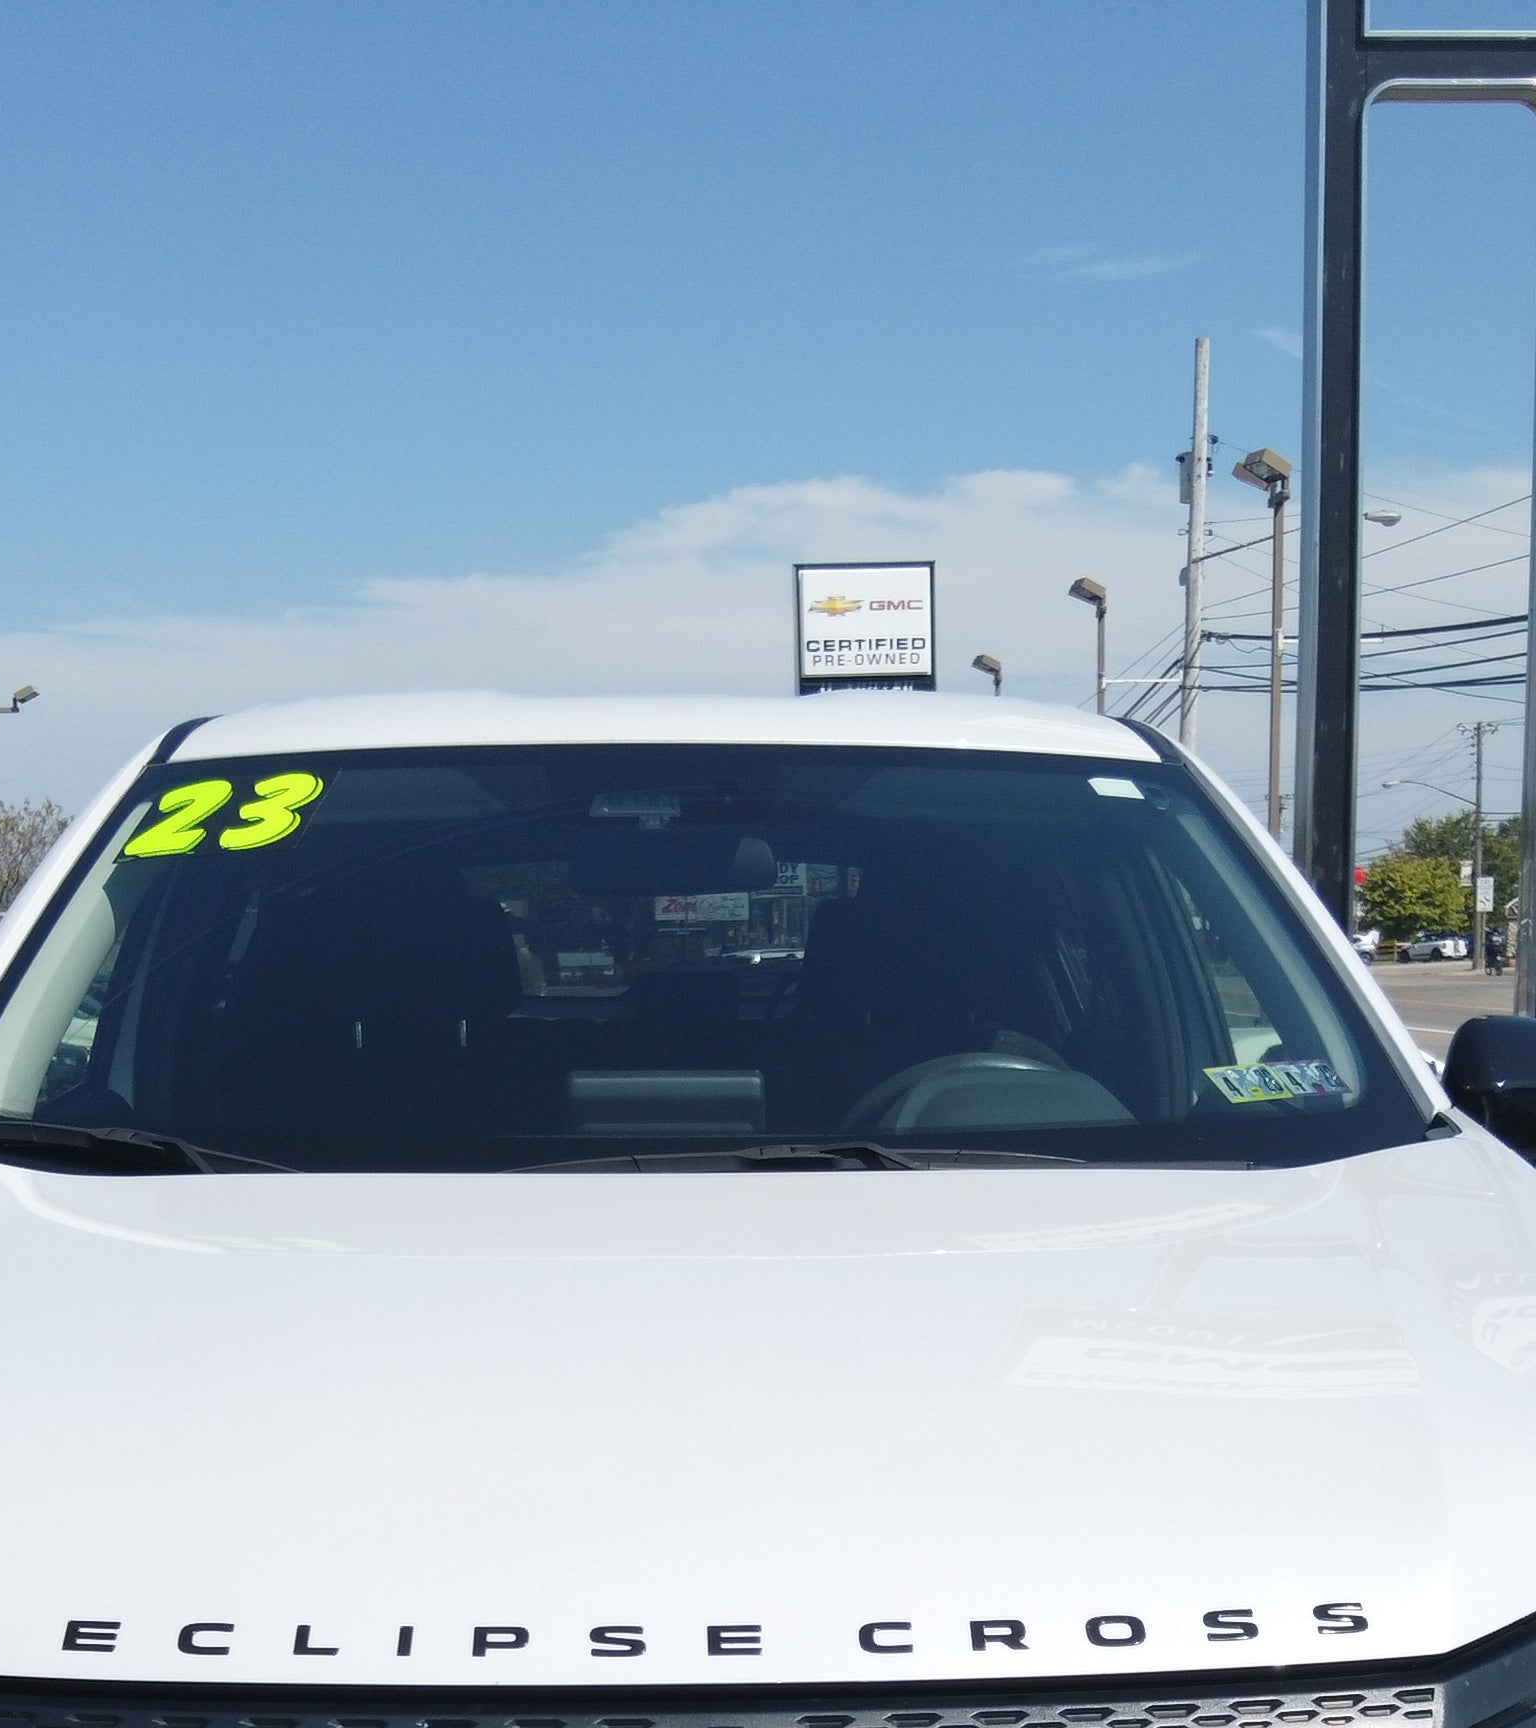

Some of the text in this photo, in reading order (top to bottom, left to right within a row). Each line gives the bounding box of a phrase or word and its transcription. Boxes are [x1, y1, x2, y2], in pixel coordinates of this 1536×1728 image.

[869, 600, 923, 611] GMC
[806, 637, 926, 653] CERTIFIED
[813, 652, 921, 667] PRE-OWNED
[123, 770, 325, 859] 23
[61, 1602, 1370, 1658] ECLIPSE CROSS
